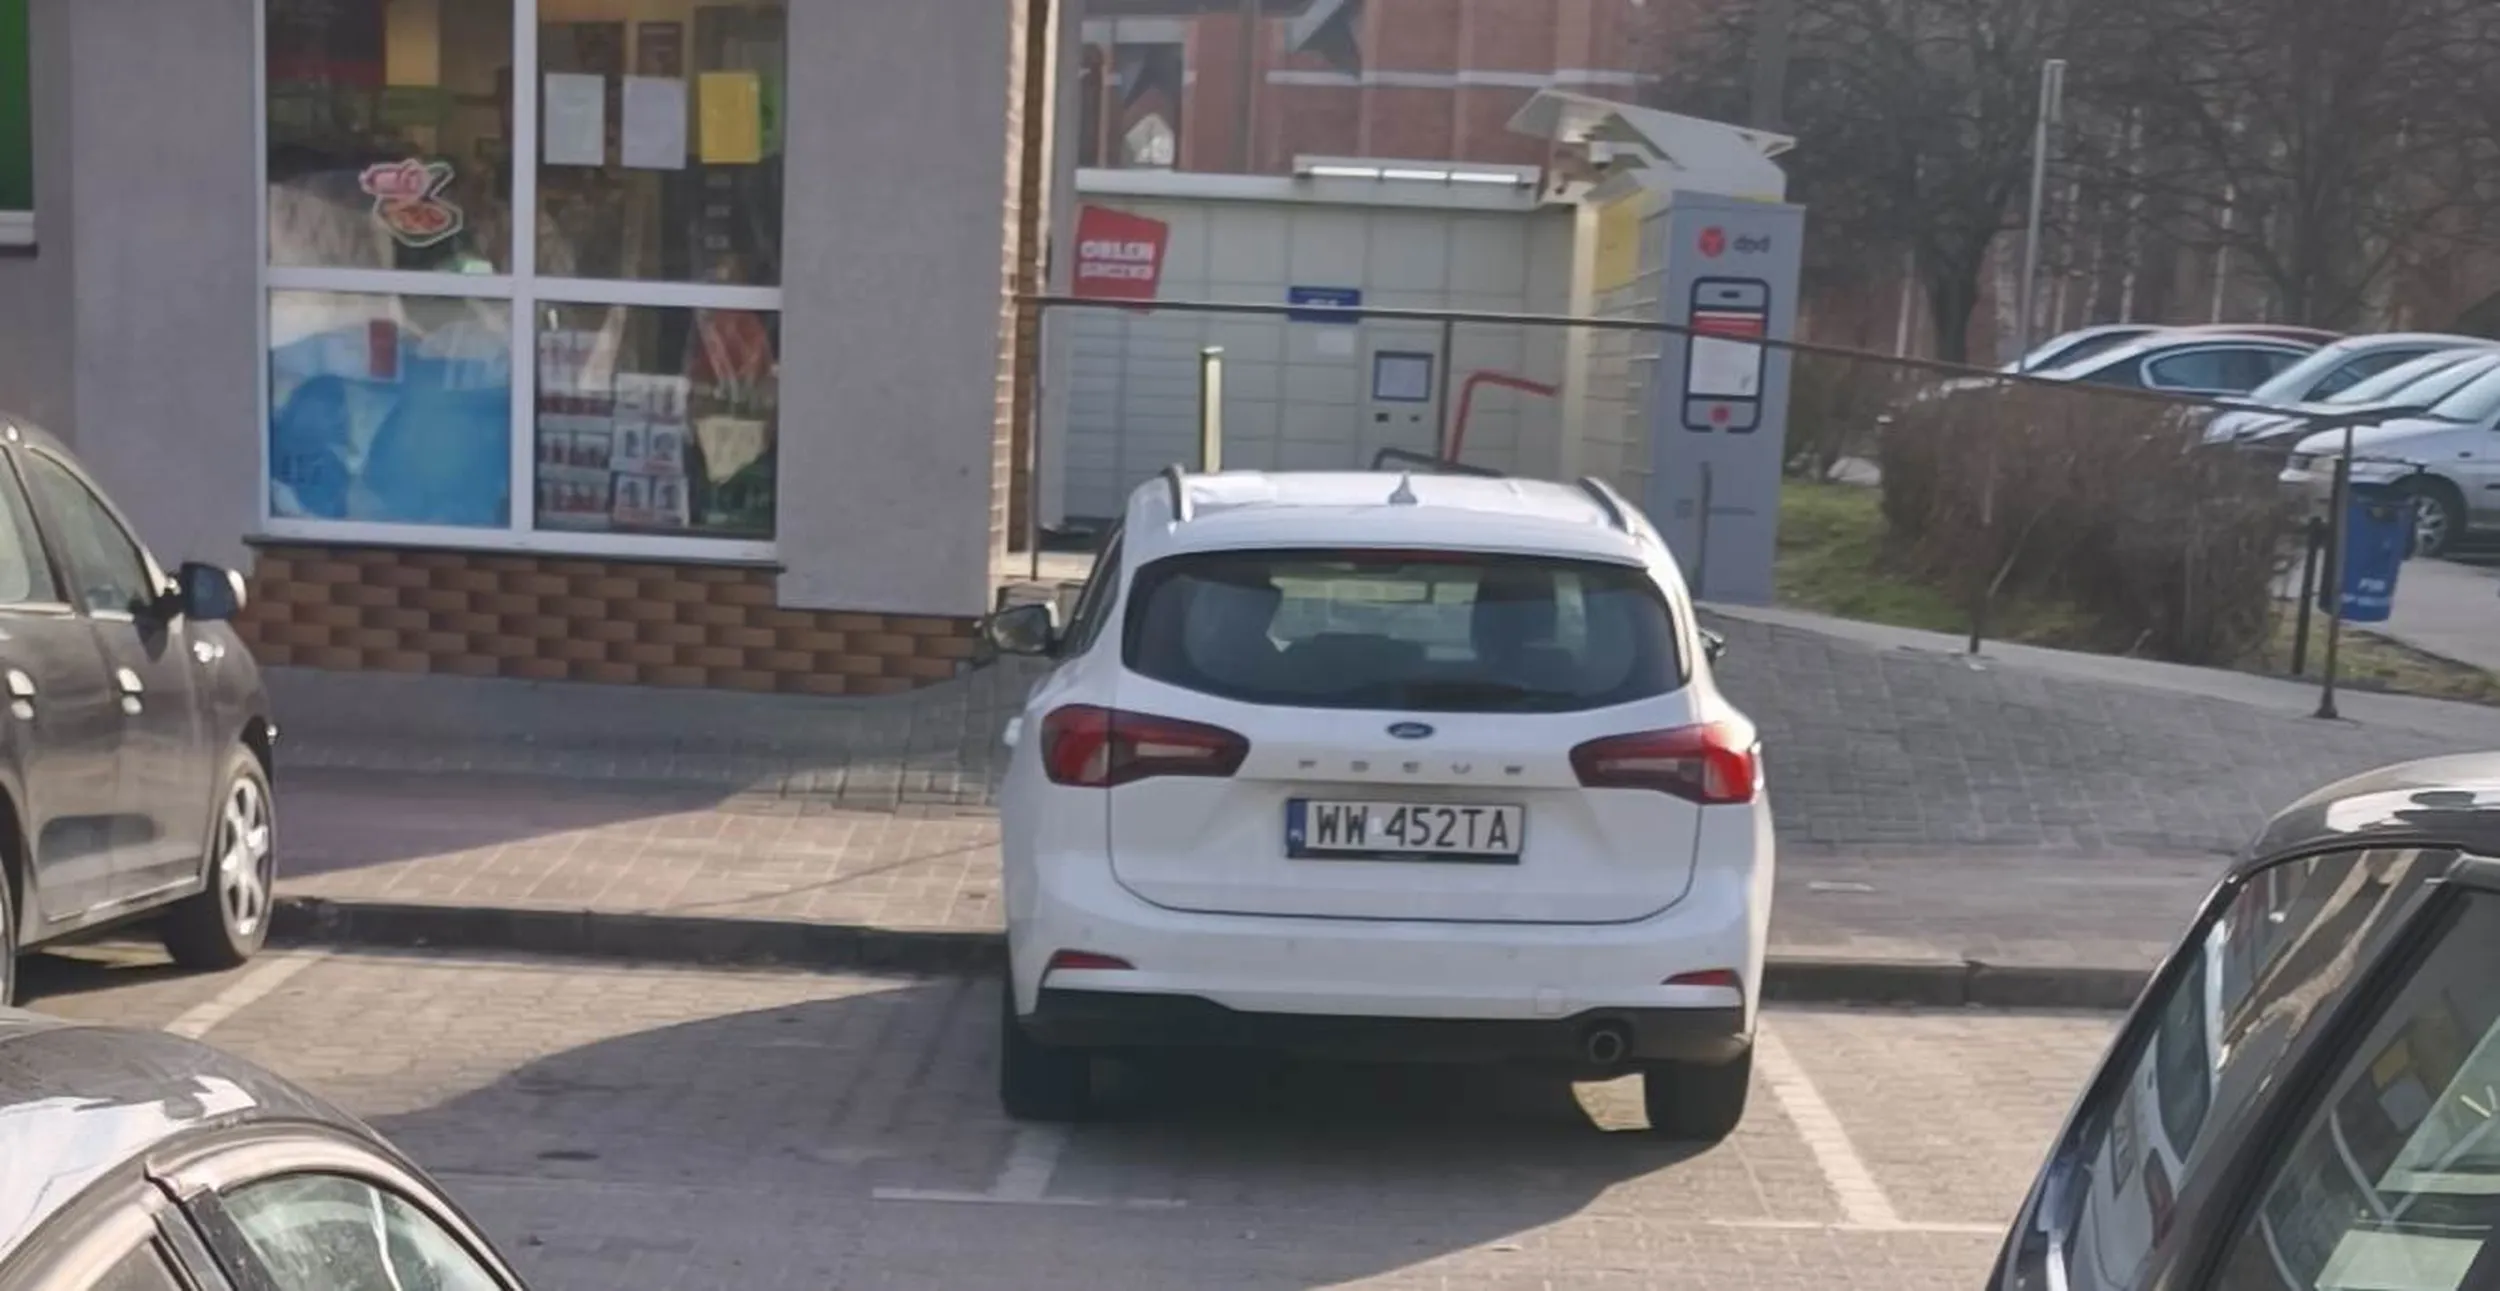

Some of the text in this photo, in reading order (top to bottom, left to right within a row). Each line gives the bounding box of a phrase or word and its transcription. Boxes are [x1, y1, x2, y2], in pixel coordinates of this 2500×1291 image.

[1080, 239, 1156, 261] ORLEN
[1732, 232, 1771, 254] dpd
[1316, 805, 1510, 849] WW 452TA
